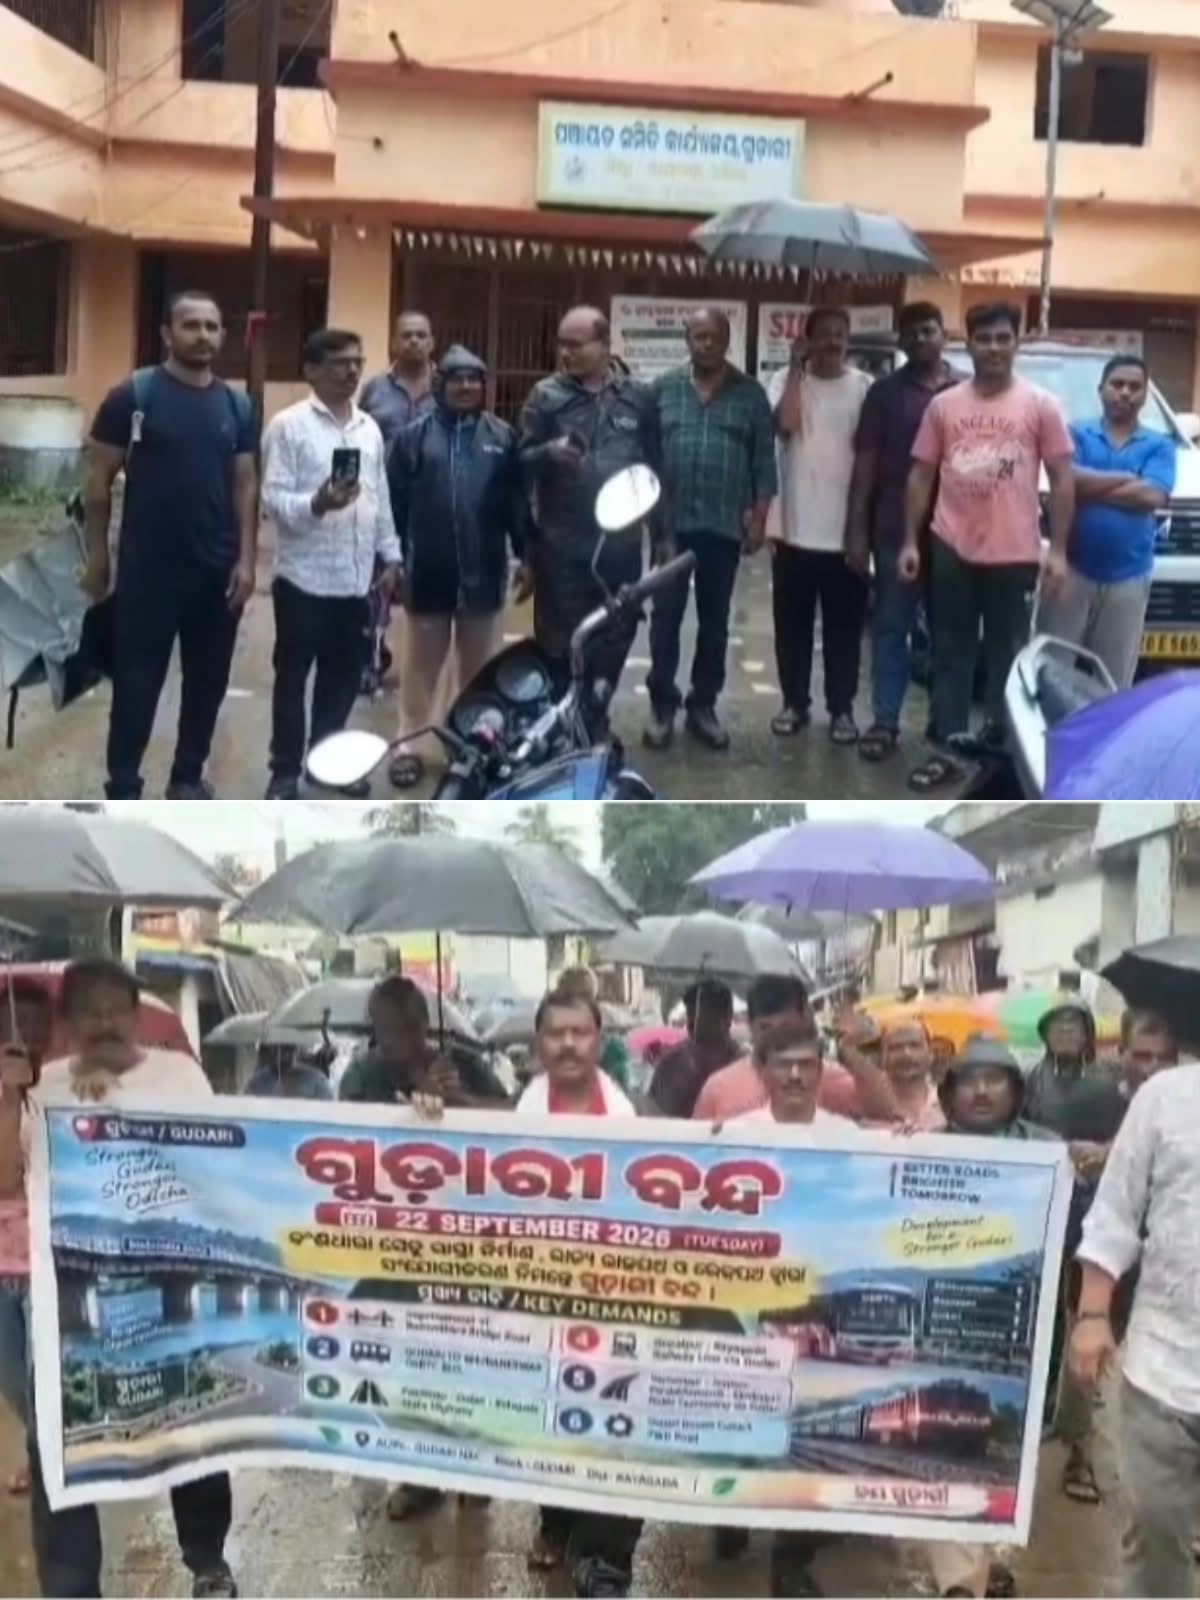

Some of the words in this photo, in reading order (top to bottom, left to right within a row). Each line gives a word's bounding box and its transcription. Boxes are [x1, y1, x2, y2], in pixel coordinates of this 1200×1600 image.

[998, 458, 1015, 480] 24
[170, 1126, 234, 1144] GUDARI
[295, 1136, 606, 1206] ଗୁଡ଼ାରୀ
[624, 1152, 783, 1216] ବନ୍ଦ
[903, 1161, 950, 1176] BETTER
[954, 1164, 999, 1179] ROADS
[901, 1187, 981, 1204] TOMORROW
[395, 1210, 430, 1230] 22
[439, 1213, 600, 1241] SEPTEMBER
[607, 1223, 671, 1248] 2026
[683, 1233, 765, 1253] (TUESDAY)
[901, 1215, 984, 1233] Development
[903, 1241, 960, 1257] Stronger
[581, 1270, 656, 1295] ଗୁଡ଼ାରୀ
[523, 1293, 567, 1314] KEY
[571, 1297, 682, 1326] DEMANDS
[615, 1472, 679, 1489] RAYAGADA
